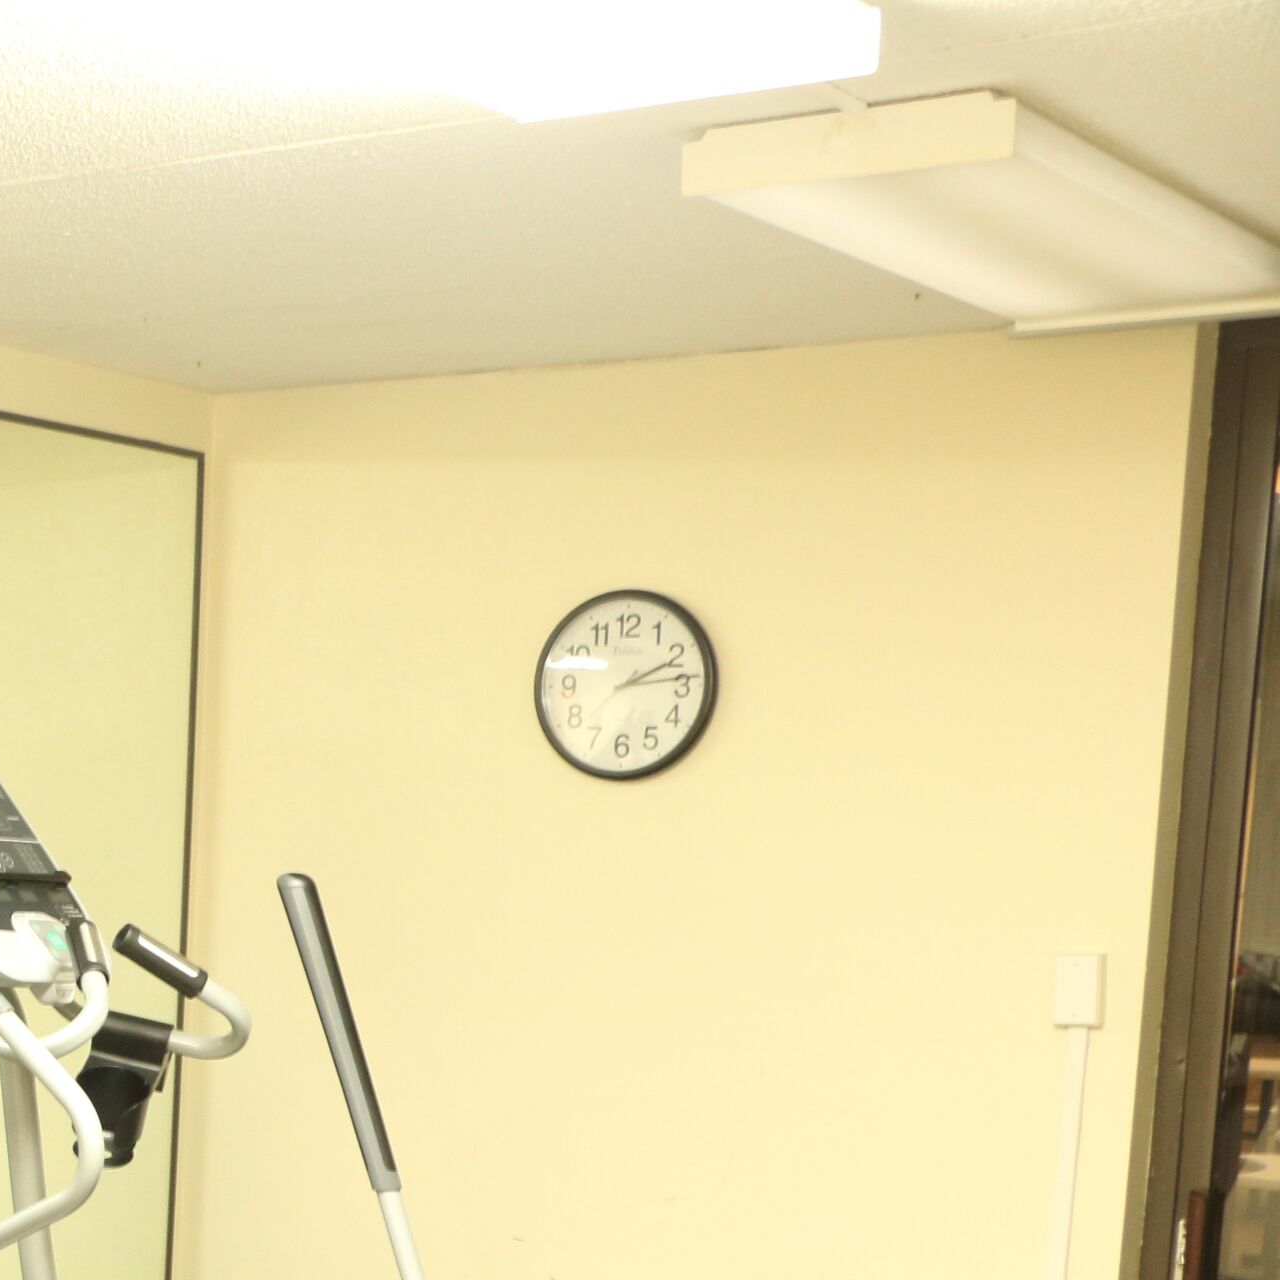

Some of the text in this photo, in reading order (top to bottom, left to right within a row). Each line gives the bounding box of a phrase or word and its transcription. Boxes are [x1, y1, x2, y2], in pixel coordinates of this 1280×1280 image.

[591, 622, 610, 646] 11
[615, 613, 641, 638] 12
[652, 621, 662, 645] 1
[667, 643, 685, 667] 2
[561, 675, 577, 699] 9
[674, 674, 690, 699] 3
[567, 704, 582, 728] 8
[665, 704, 682, 728] 4
[587, 726, 603, 751] 7
[614, 734, 630, 758] 6
[643, 726, 659, 750] 5
